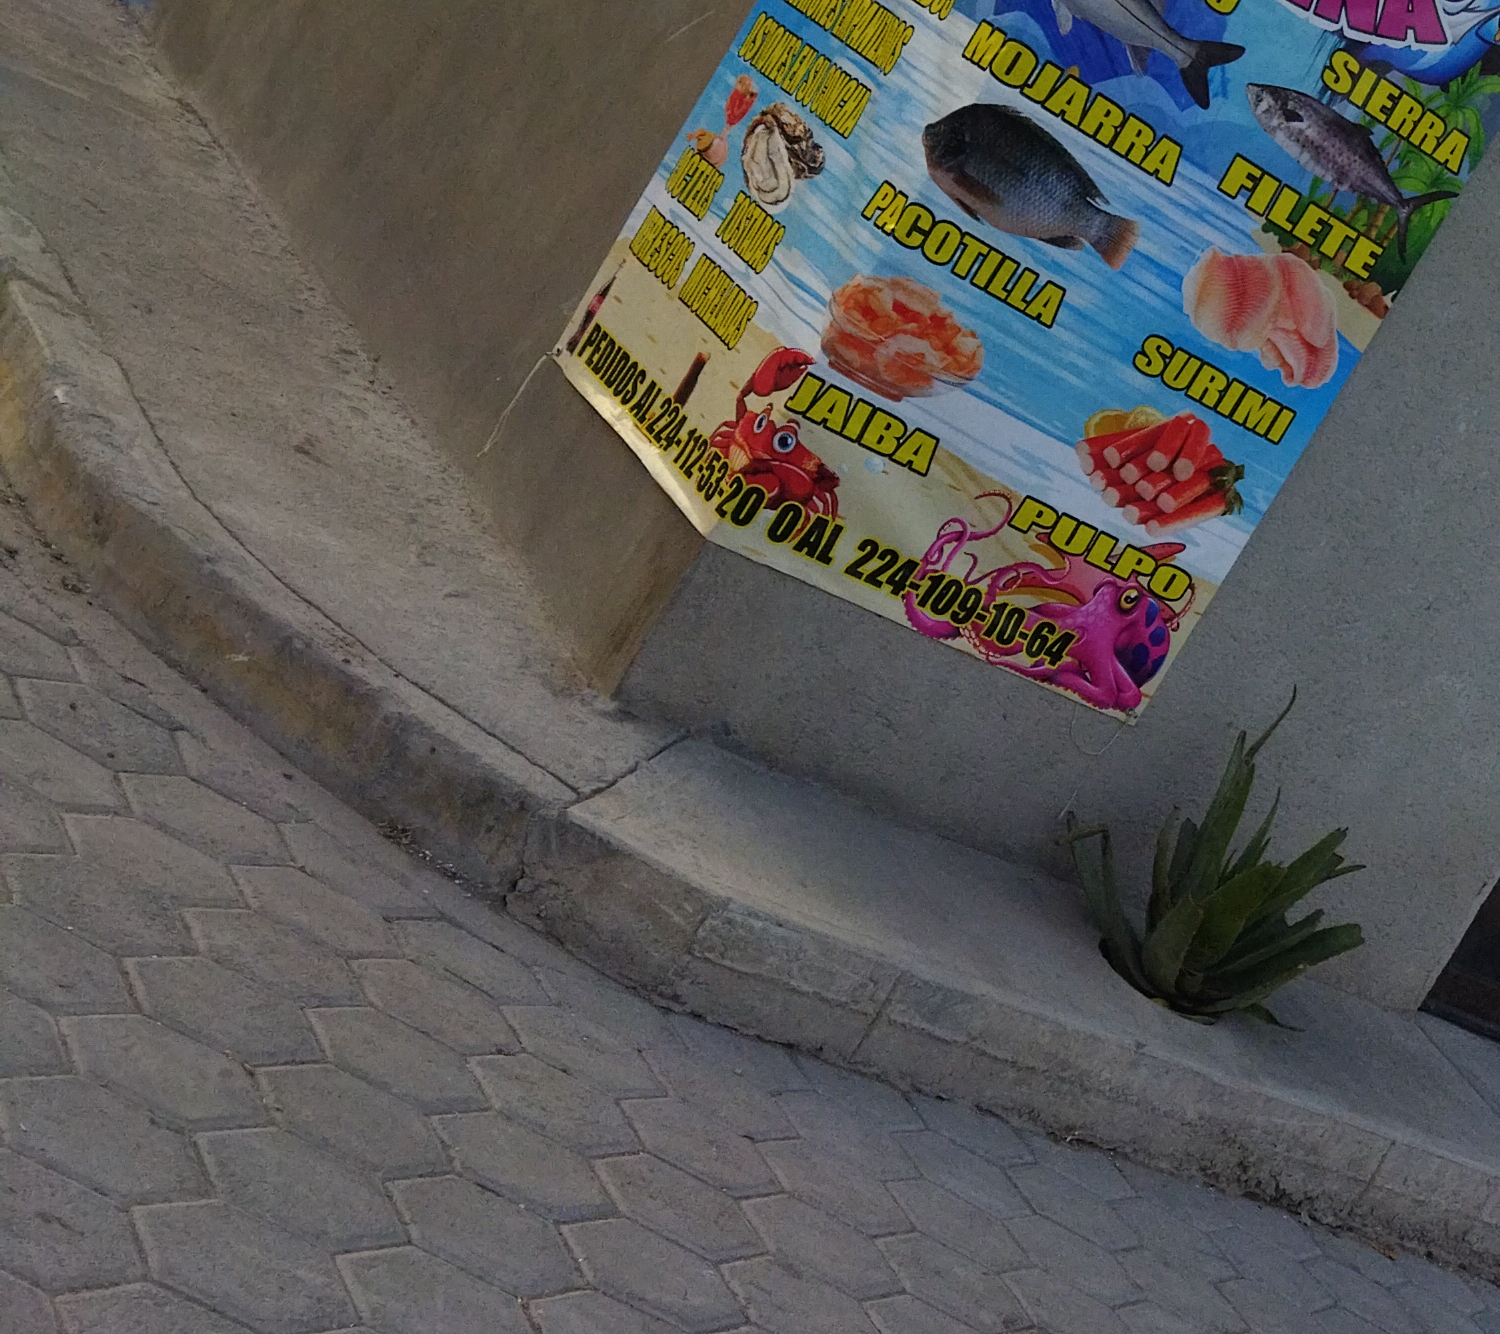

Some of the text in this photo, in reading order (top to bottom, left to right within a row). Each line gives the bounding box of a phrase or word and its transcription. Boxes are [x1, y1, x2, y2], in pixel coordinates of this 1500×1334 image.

[736, 10, 875, 140] OSTIONES EN SU CONCHA
[962, 21, 1183, 186] MOJARRA
[1322, 48, 1471, 175] SIERRA
[713, 189, 787, 277] TOSTADAS
[861, 181, 1066, 329] PACOTILLA
[1216, 154, 1386, 280] FILETE
[676, 250, 760, 353] MICHELADAS
[576, 322, 646, 407] PEDIDOS
[627, 378, 663, 426] AL
[1133, 334, 1298, 445] SURIMI
[643, 395, 769, 528] 224-112-53-20
[784, 373, 939, 477] JAIBA
[792, 515, 848, 567] AL
[1007, 495, 1192, 602] PULPO
[844, 539, 1077, 667] 224-109-10-64
